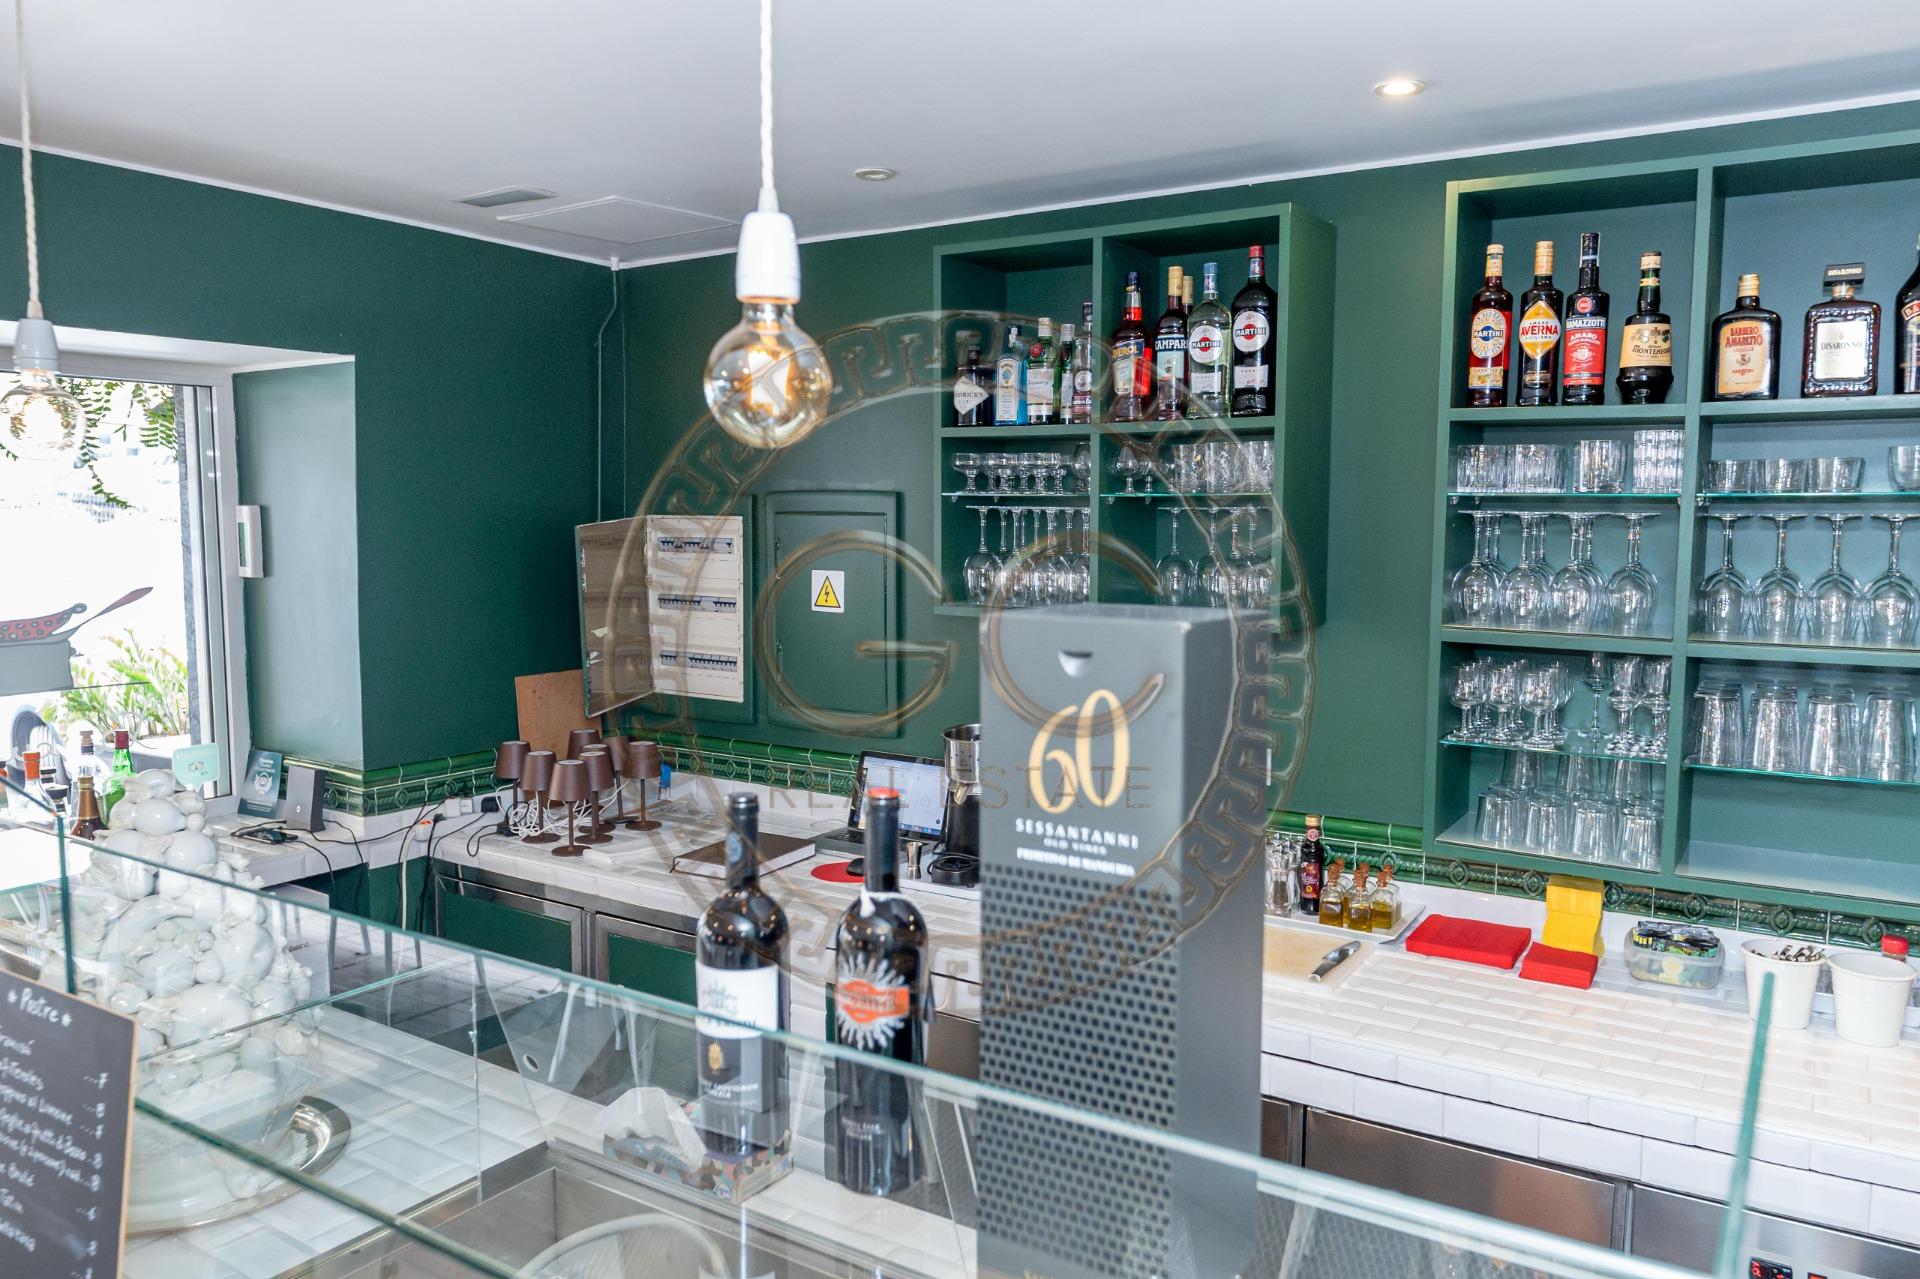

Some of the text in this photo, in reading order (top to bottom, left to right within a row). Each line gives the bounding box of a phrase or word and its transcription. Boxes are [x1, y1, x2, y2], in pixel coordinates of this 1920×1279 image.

[1566, 319, 1606, 329] RAMAZZOTTI
[1234, 327, 1267, 338] MARTINI
[1473, 329, 1503, 338] MARTINI
[1520, 325, 1559, 337] AVERNA
[1730, 326, 1759, 336] BARBERO
[1570, 332, 1598, 341] AMARO
[1725, 335, 1763, 347] AMARETTO
[1192, 340, 1220, 349] MARTINI
[1820, 341, 1862, 350] DISARONNO
[1112, 345, 1140, 360] APEROL
[1029, 689, 1131, 814] 60
[1015, 817, 1140, 850] SESSANTANNI
